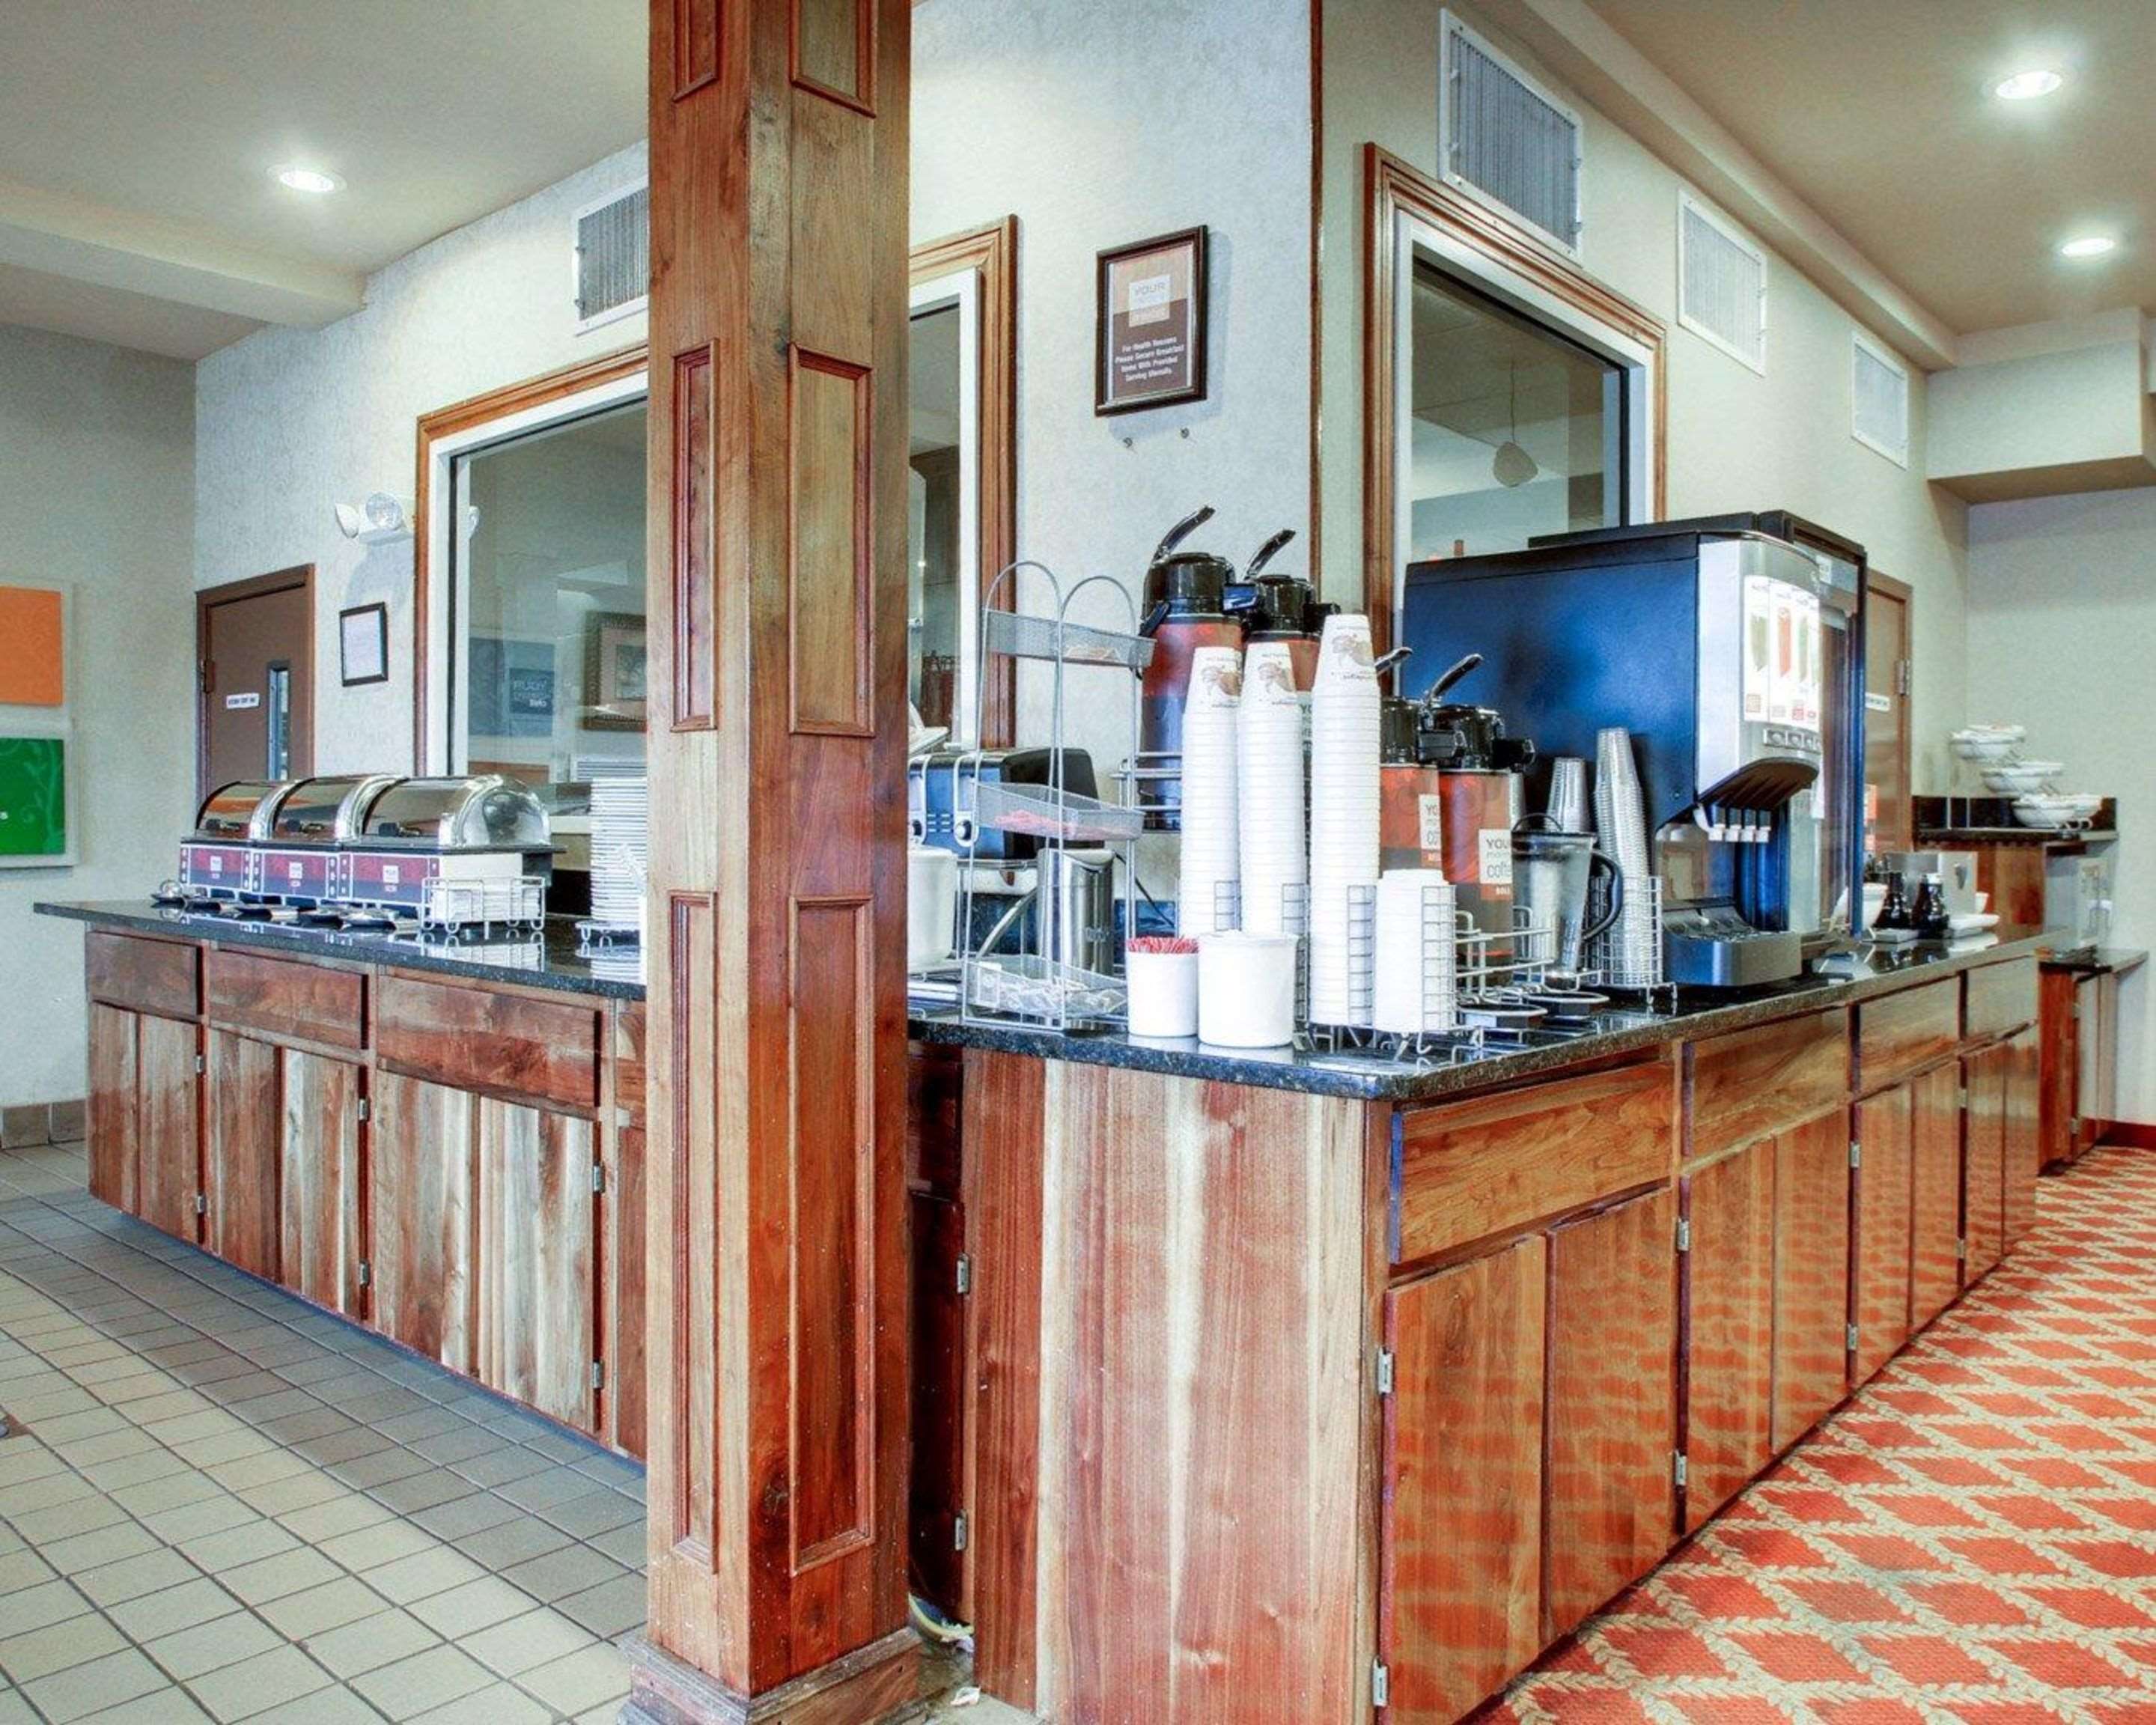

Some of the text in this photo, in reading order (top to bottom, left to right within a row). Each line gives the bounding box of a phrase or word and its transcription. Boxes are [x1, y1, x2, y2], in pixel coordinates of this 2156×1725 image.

[1134, 282, 1166, 295] YOUR
[1133, 341, 1151, 350] Health
[1115, 356, 1133, 364] Please
[1135, 351, 1155, 360] Secure
[1153, 356, 1178, 366] Provided
[1125, 372, 1147, 382] Serving
